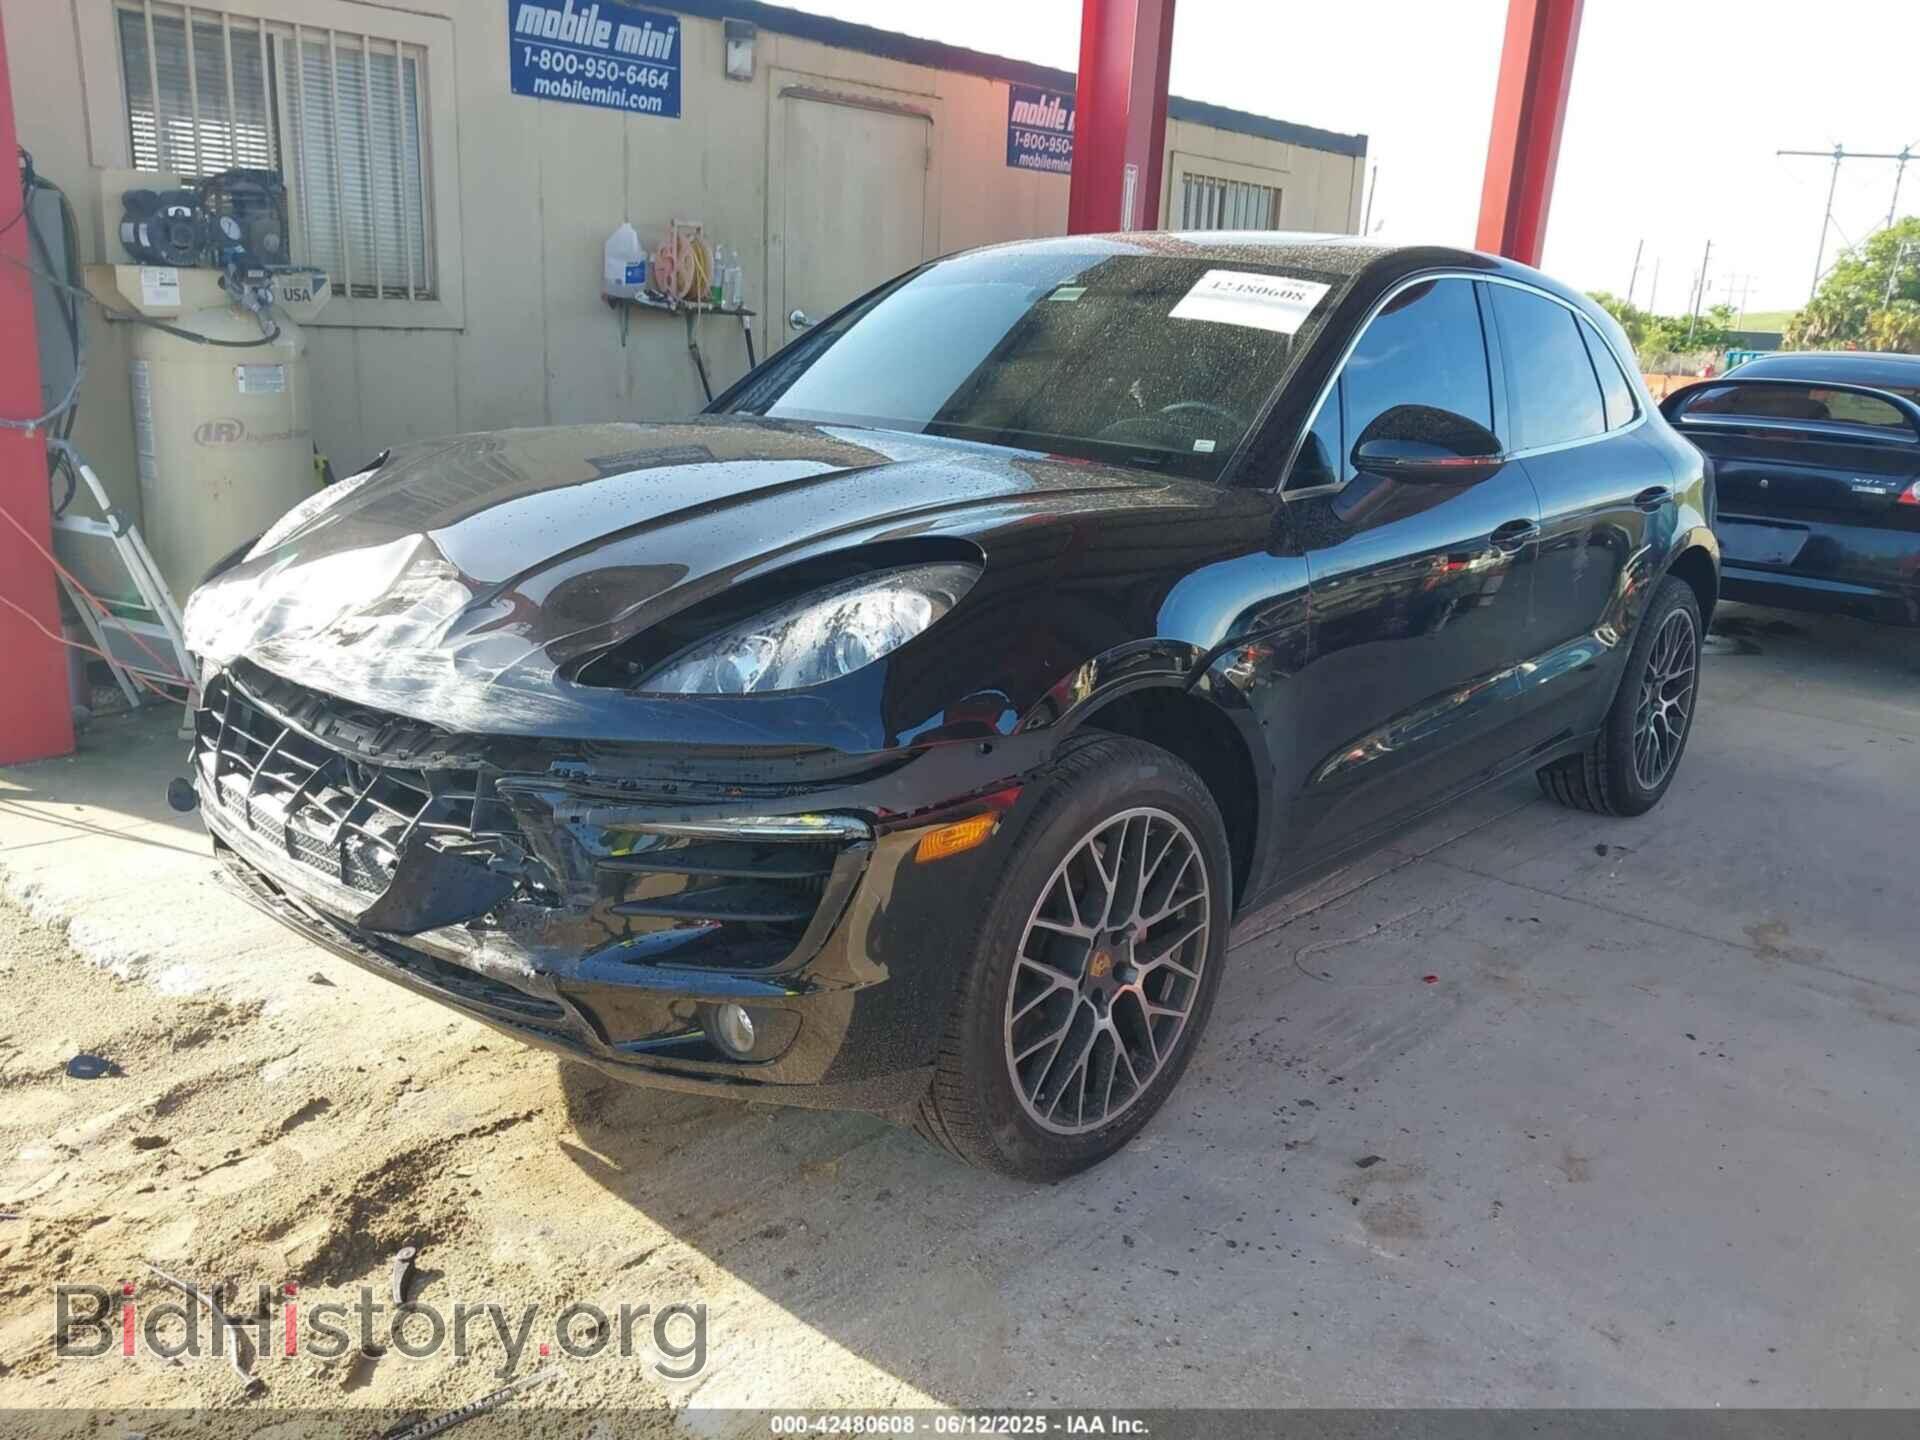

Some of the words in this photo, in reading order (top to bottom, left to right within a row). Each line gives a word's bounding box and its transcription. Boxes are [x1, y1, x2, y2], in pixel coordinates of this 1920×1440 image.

[515, 0, 611, 48] mobile
[614, 21, 674, 60] mini
[523, 46, 669, 90] 1-800-950-6464
[533, 77, 662, 112] mobilemini.com
[1011, 94, 1067, 130] mobile
[283, 287, 311, 302] USA
